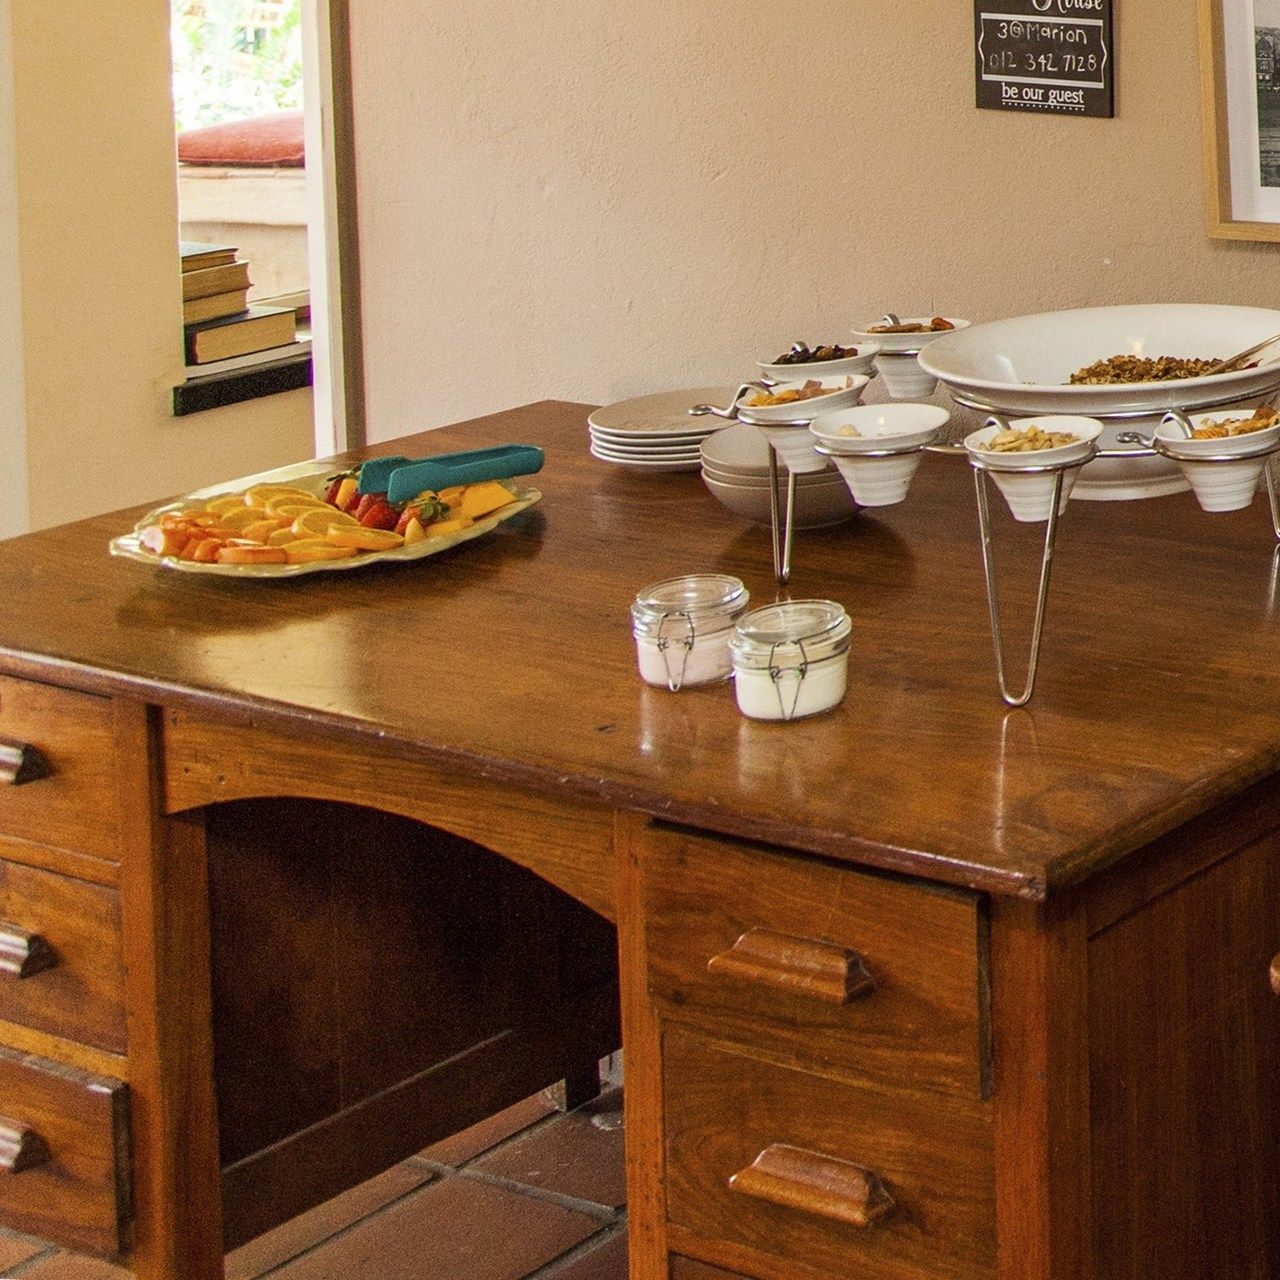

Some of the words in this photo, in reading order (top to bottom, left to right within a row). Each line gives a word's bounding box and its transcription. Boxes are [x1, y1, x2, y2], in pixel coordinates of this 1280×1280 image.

[1024, 53, 1059, 72] 342
[1063, 53, 1097, 72] 7128
[1001, 82, 1018, 99] be
[1022, 87, 1045, 101] our
[1048, 88, 1084, 105] guest
